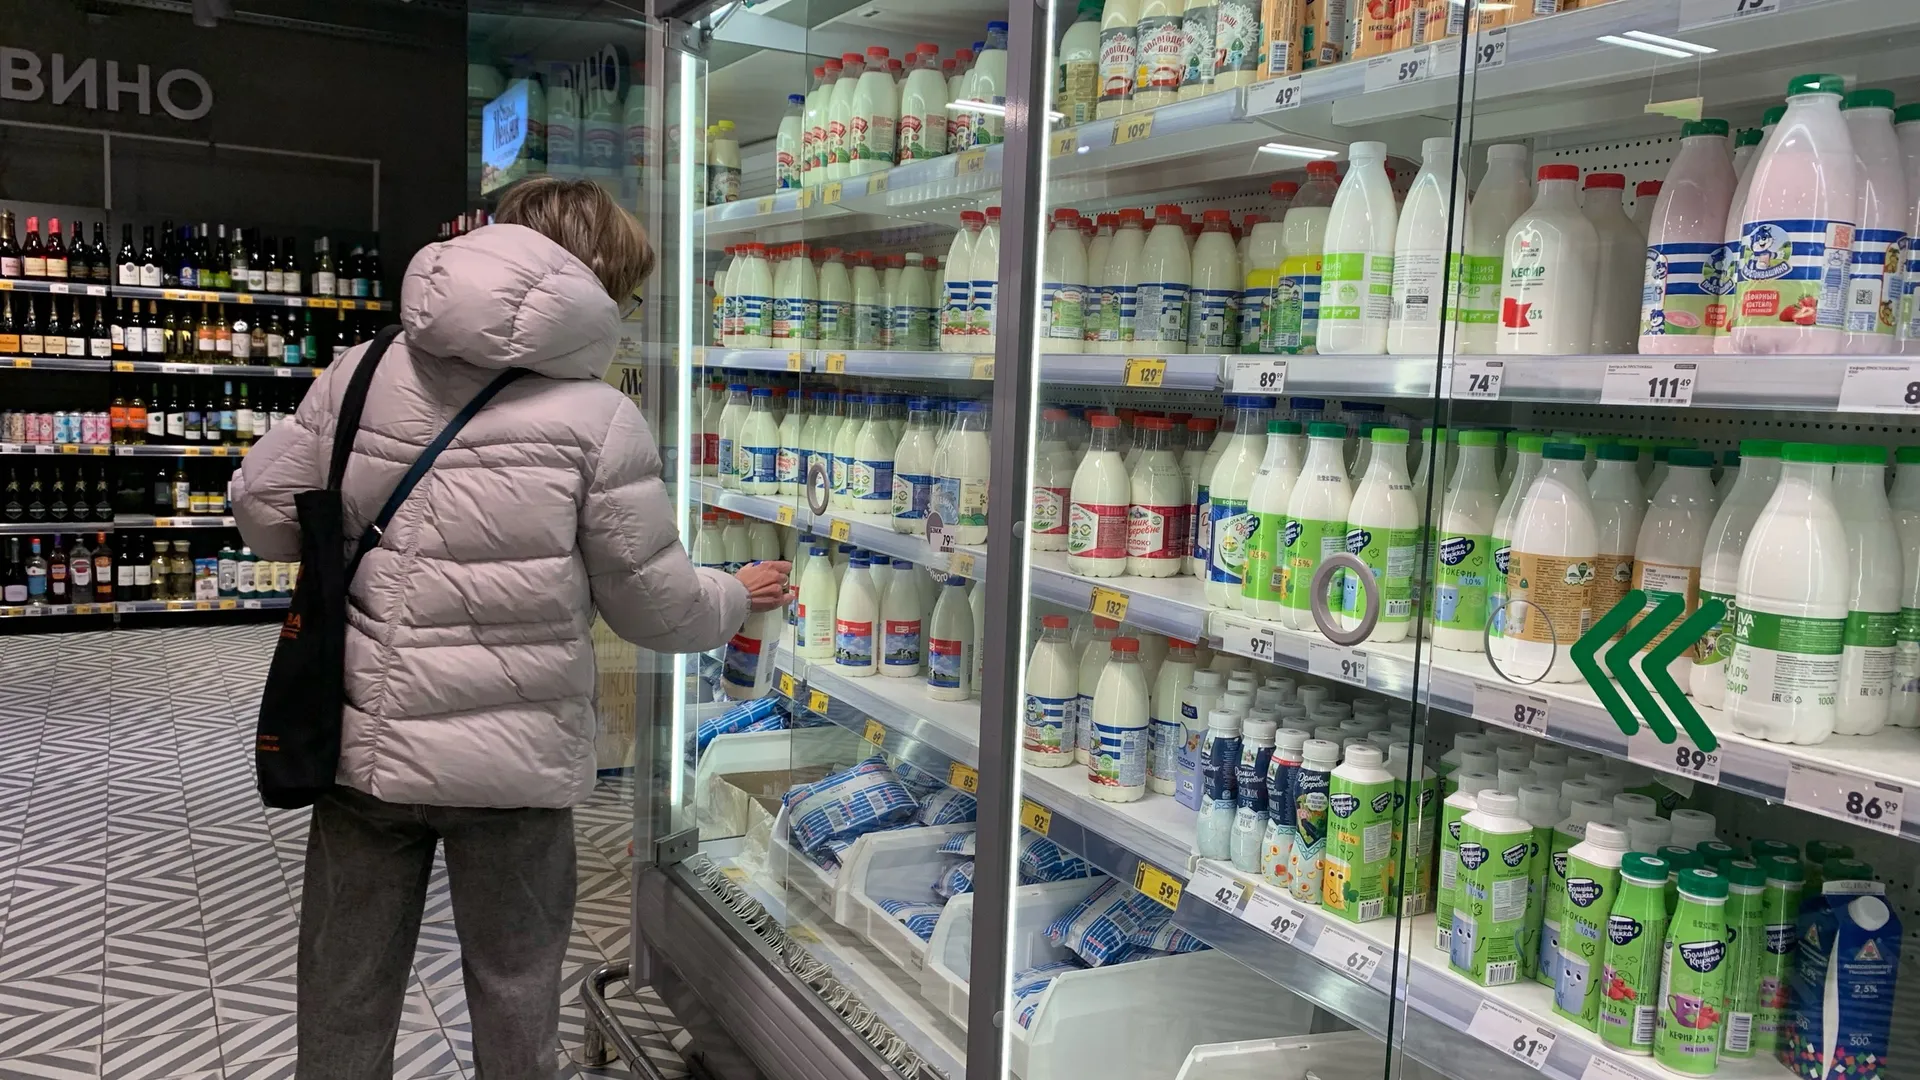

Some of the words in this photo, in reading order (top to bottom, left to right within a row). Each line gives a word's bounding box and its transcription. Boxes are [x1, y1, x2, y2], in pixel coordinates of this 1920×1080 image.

[1398, 60, 1420, 81] 59
[0, 45, 213, 121] ВИНО
[1275, 88, 1294, 106] 49
[1127, 122, 1146, 140] 109
[1511, 266, 1545, 278] КЕФИР
[1140, 368, 1158, 383] 129
[1259, 371, 1277, 388] 89
[1469, 374, 1490, 392] 74
[1490, 374, 1500, 384] 79
[1649, 377, 1681, 398] 111
[1679, 378, 1692, 388] 49
[1105, 599, 1121, 615] 132
[1250, 637, 1267, 654] 97
[1341, 659, 1358, 678] 91
[1729, 664, 1749, 681] 1,0%
[1513, 703, 1537, 725] 87
[1675, 746, 1706, 770] 89
[1706, 754, 1718, 764] 99
[962, 775, 975, 788] 85
[1298, 772, 1322, 783] Домик
[1846, 791, 1883, 819] 86
[1884, 800, 1898, 812] 99
[1034, 813, 1045, 828] 92
[1158, 881, 1173, 899] 59
[1215, 887, 1233, 905] 42
[1270, 915, 1289, 932] 49
[1346, 951, 1369, 971] 67
[1683, 948, 1720, 960] Большая
[1689, 955, 1721, 967] Кружка
[1854, 984, 1878, 995] 2,5%
[1669, 1029, 1693, 1042] КЕФИР
[1850, 1036, 1869, 1046] 500
[1513, 1034, 1538, 1057] 61
[1537, 1043, 1548, 1053] 99
